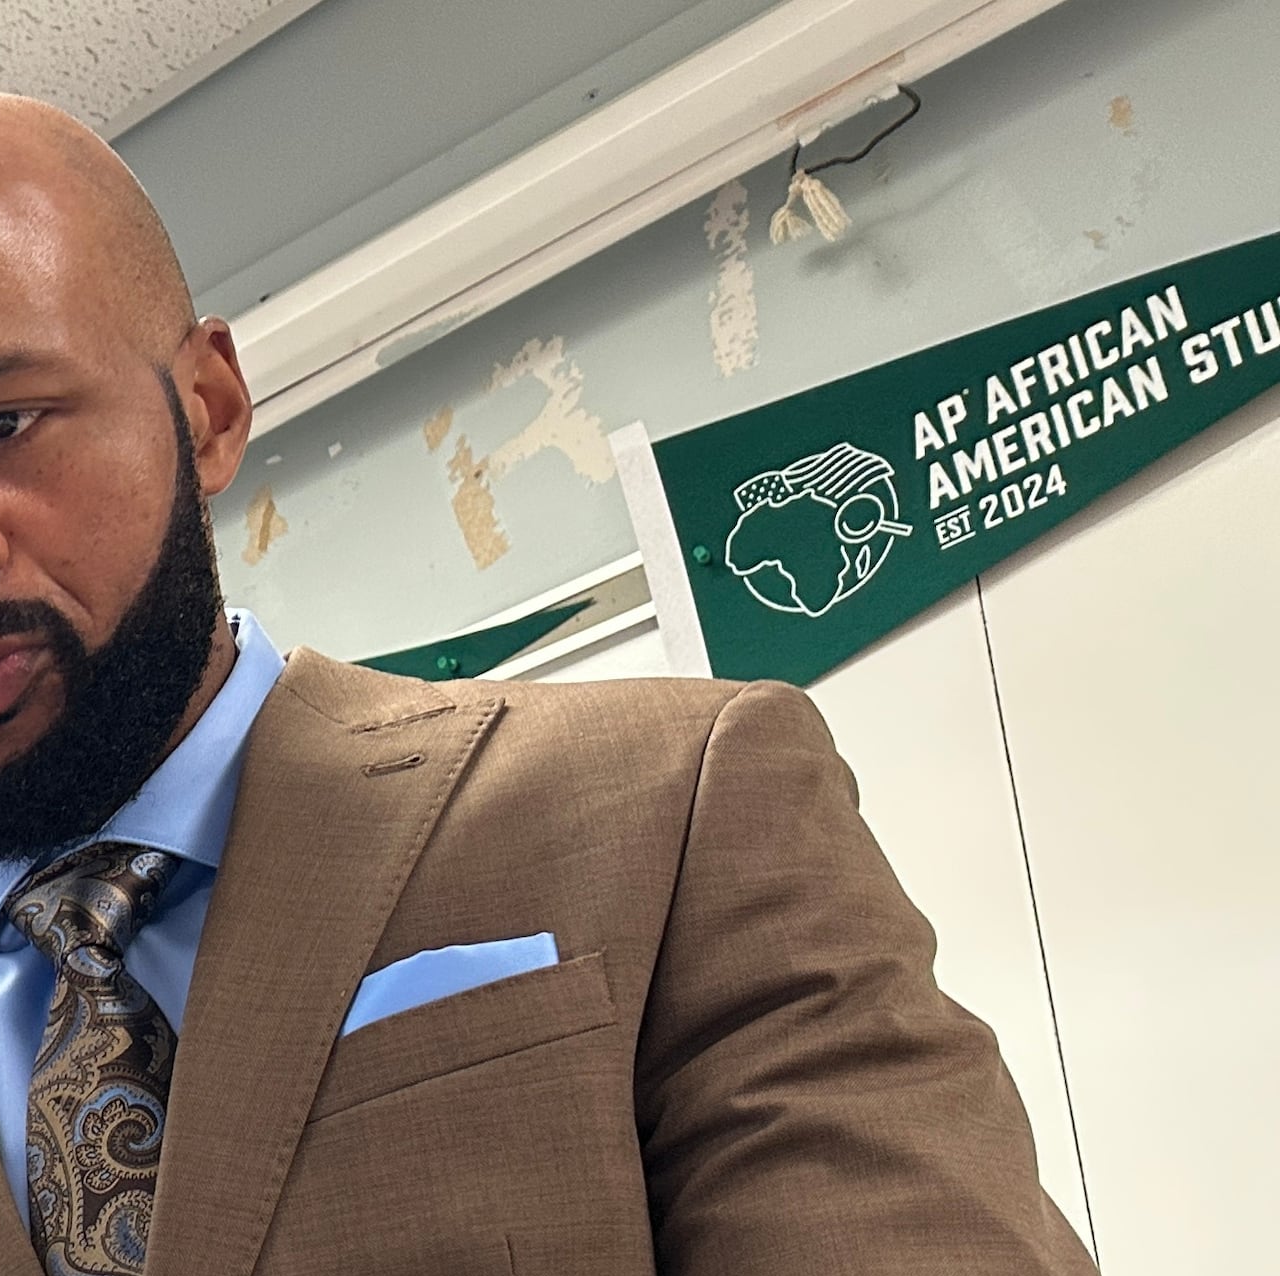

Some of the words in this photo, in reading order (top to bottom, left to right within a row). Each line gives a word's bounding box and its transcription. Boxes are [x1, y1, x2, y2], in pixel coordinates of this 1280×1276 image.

[913, 396, 966, 460] AP
[985, 285, 1190, 421] AFRICAN
[929, 355, 1169, 510] AMERICAN
[1180, 295, 1280, 384] STU
[935, 511, 974, 545] EST
[979, 464, 1067, 530] 2024
